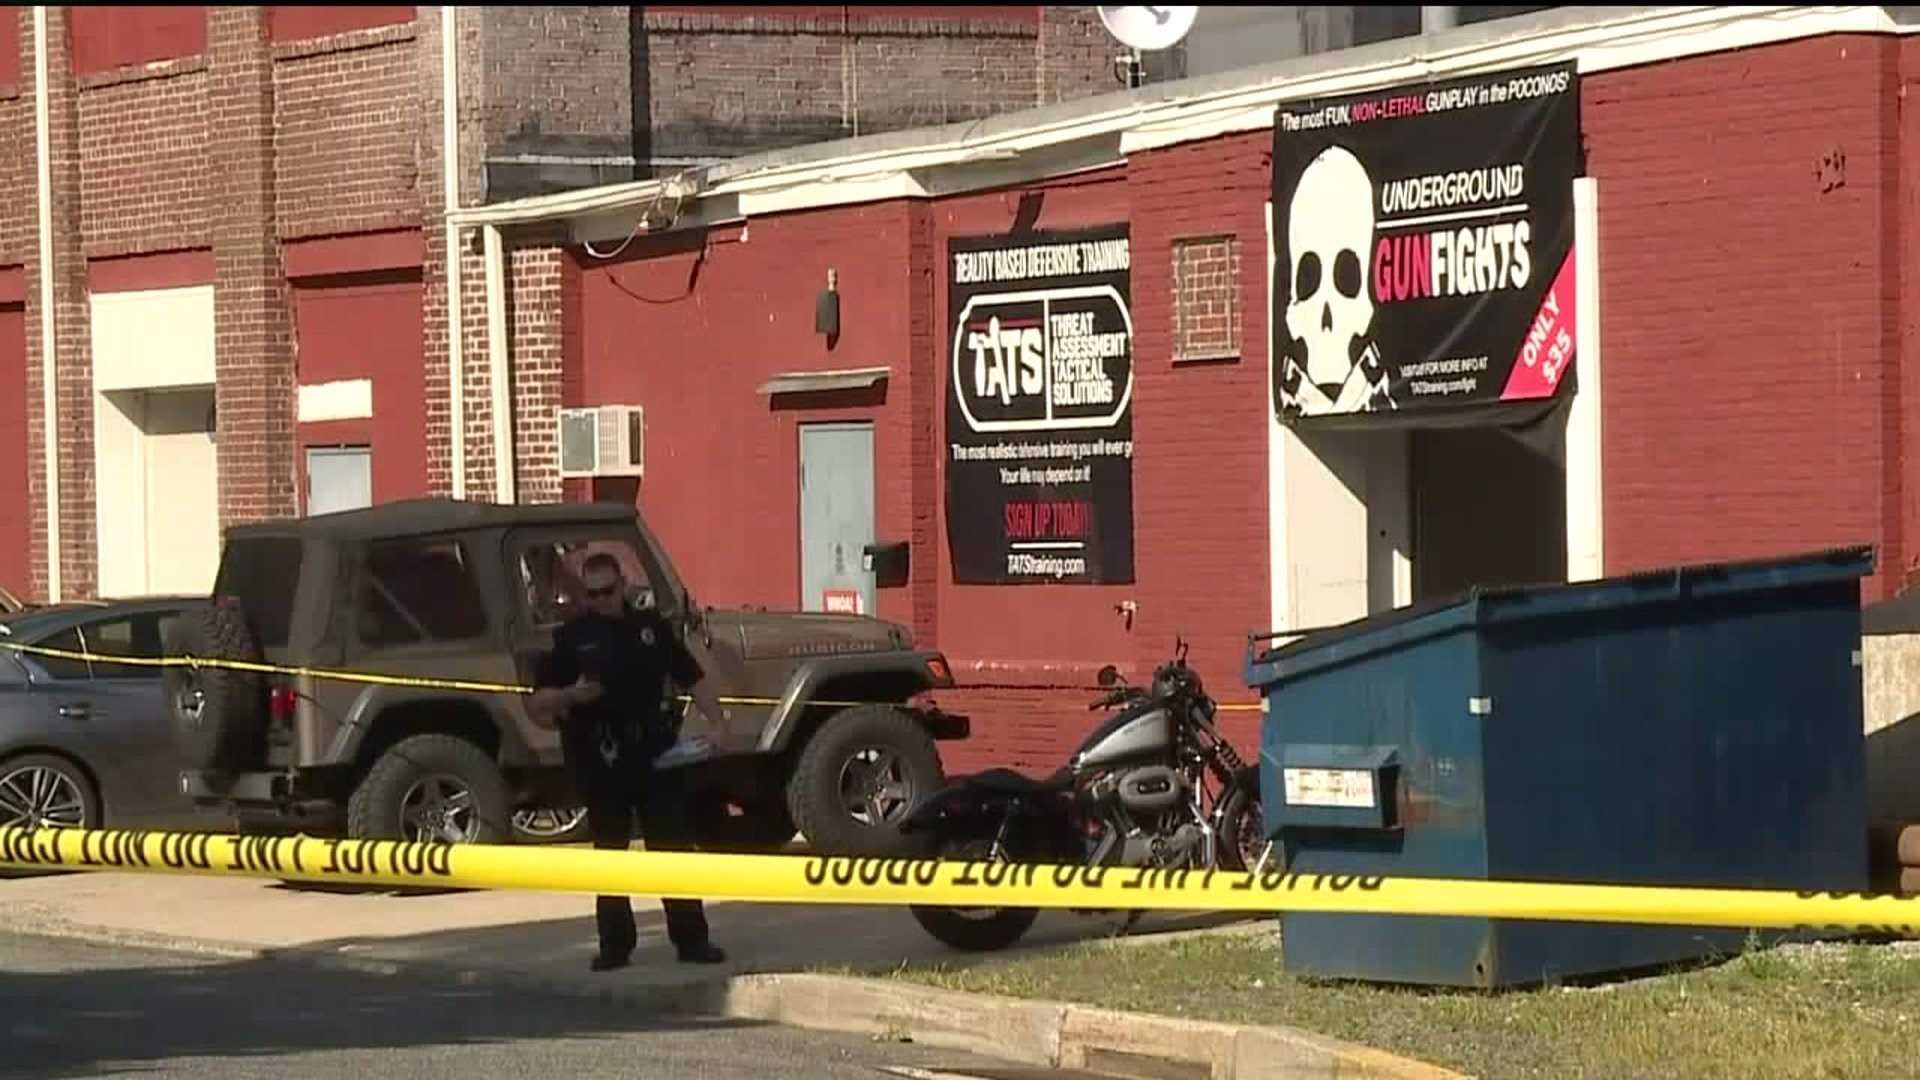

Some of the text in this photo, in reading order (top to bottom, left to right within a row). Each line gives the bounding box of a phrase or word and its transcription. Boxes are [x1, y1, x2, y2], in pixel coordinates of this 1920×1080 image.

[1282, 112, 1300, 131] The
[1301, 109, 1324, 128] most
[1352, 97, 1425, 122] NON-LETHAL
[1426, 86, 1478, 112] GUNPLAY
[1479, 85, 1489, 104] in
[1489, 83, 1507, 103] the
[1381, 164, 1524, 213] UNDERGROUND
[955, 239, 1130, 283] REALITY BASED DEFENSIVE TRAINING
[1374, 220, 1531, 303] GUNFIGHTS
[1050, 312, 1095, 337] THREAT
[1523, 290, 1561, 367] ONLY
[968, 315, 1043, 405] TATS
[1052, 332, 1127, 359] ASSESSMENT
[1542, 328, 1572, 384] $35
[1052, 357, 1107, 382] TACTICAL
[1052, 379, 1114, 405] SOLUTIONS
[952, 443, 967, 461] The
[968, 444, 987, 460] most
[1050, 439, 1078, 461] training
[1105, 440, 1124, 456] ever
[1000, 466, 1019, 484] Your
[1006, 503, 1032, 537] SIGN
[1034, 503, 1050, 537] UP
